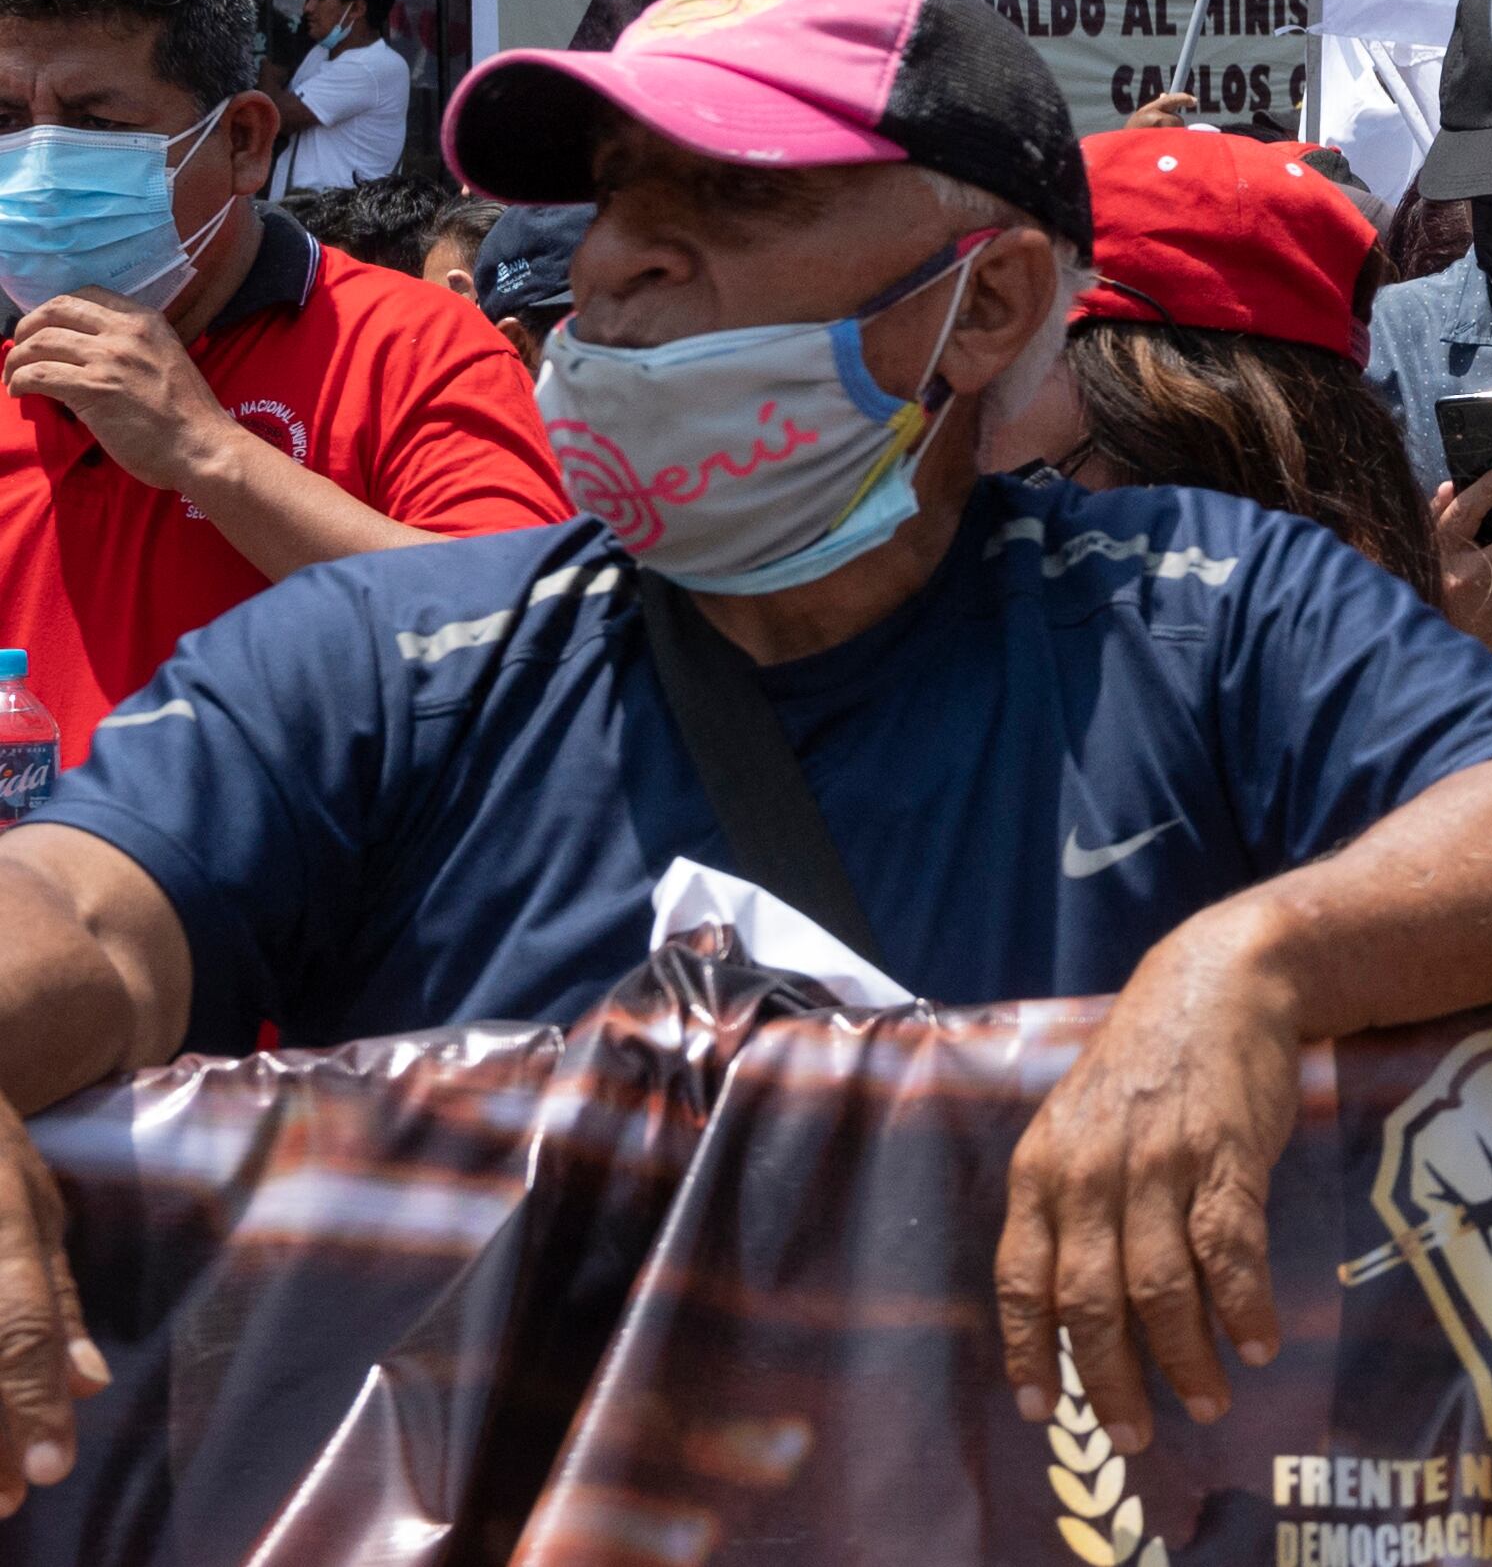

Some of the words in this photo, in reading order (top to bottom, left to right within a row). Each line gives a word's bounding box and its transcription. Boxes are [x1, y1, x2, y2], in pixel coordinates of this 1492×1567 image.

[240, 399, 295, 424] NACIONAL
[0, 762, 49, 798] ida
[1273, 1454, 1450, 1508] FRENTE
